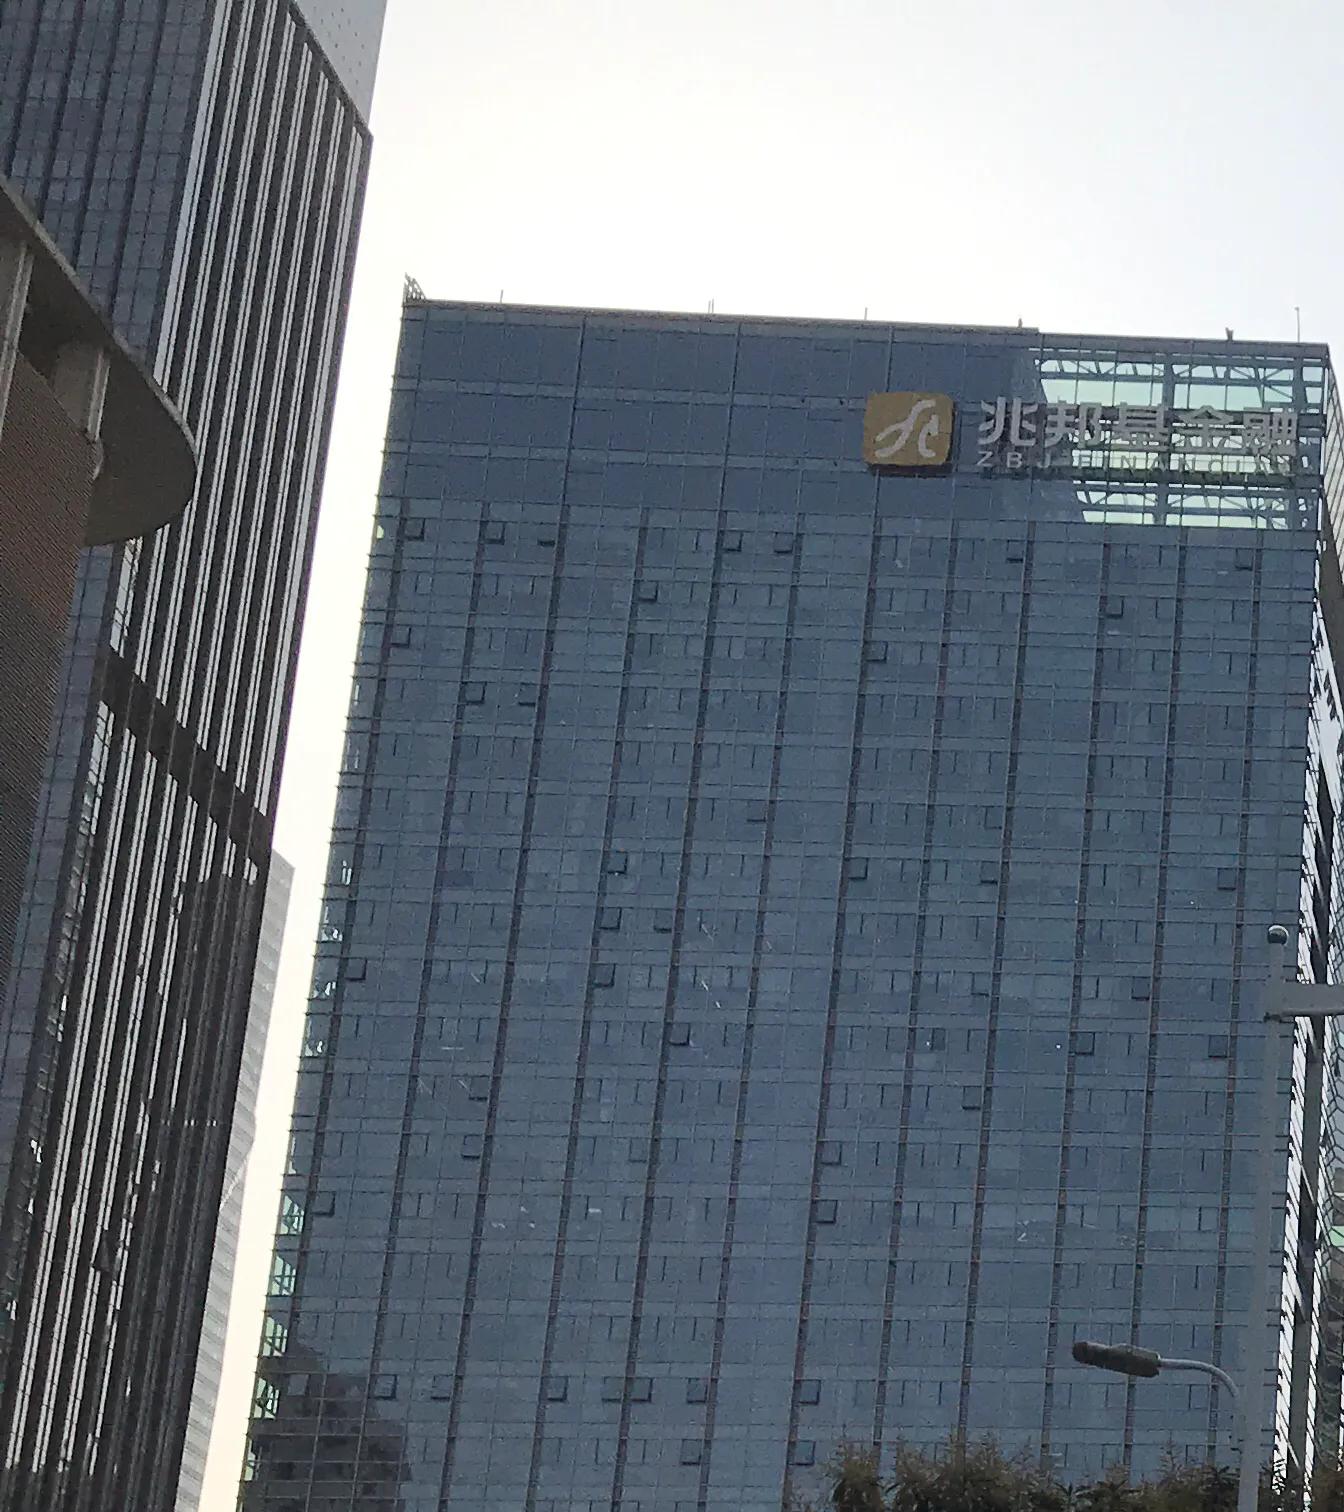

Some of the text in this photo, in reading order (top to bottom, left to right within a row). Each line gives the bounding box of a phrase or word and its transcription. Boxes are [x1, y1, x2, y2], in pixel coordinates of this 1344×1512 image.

[977, 396, 1297, 453] 兆邦基金融
[975, 450, 1050, 469] ZBJ
